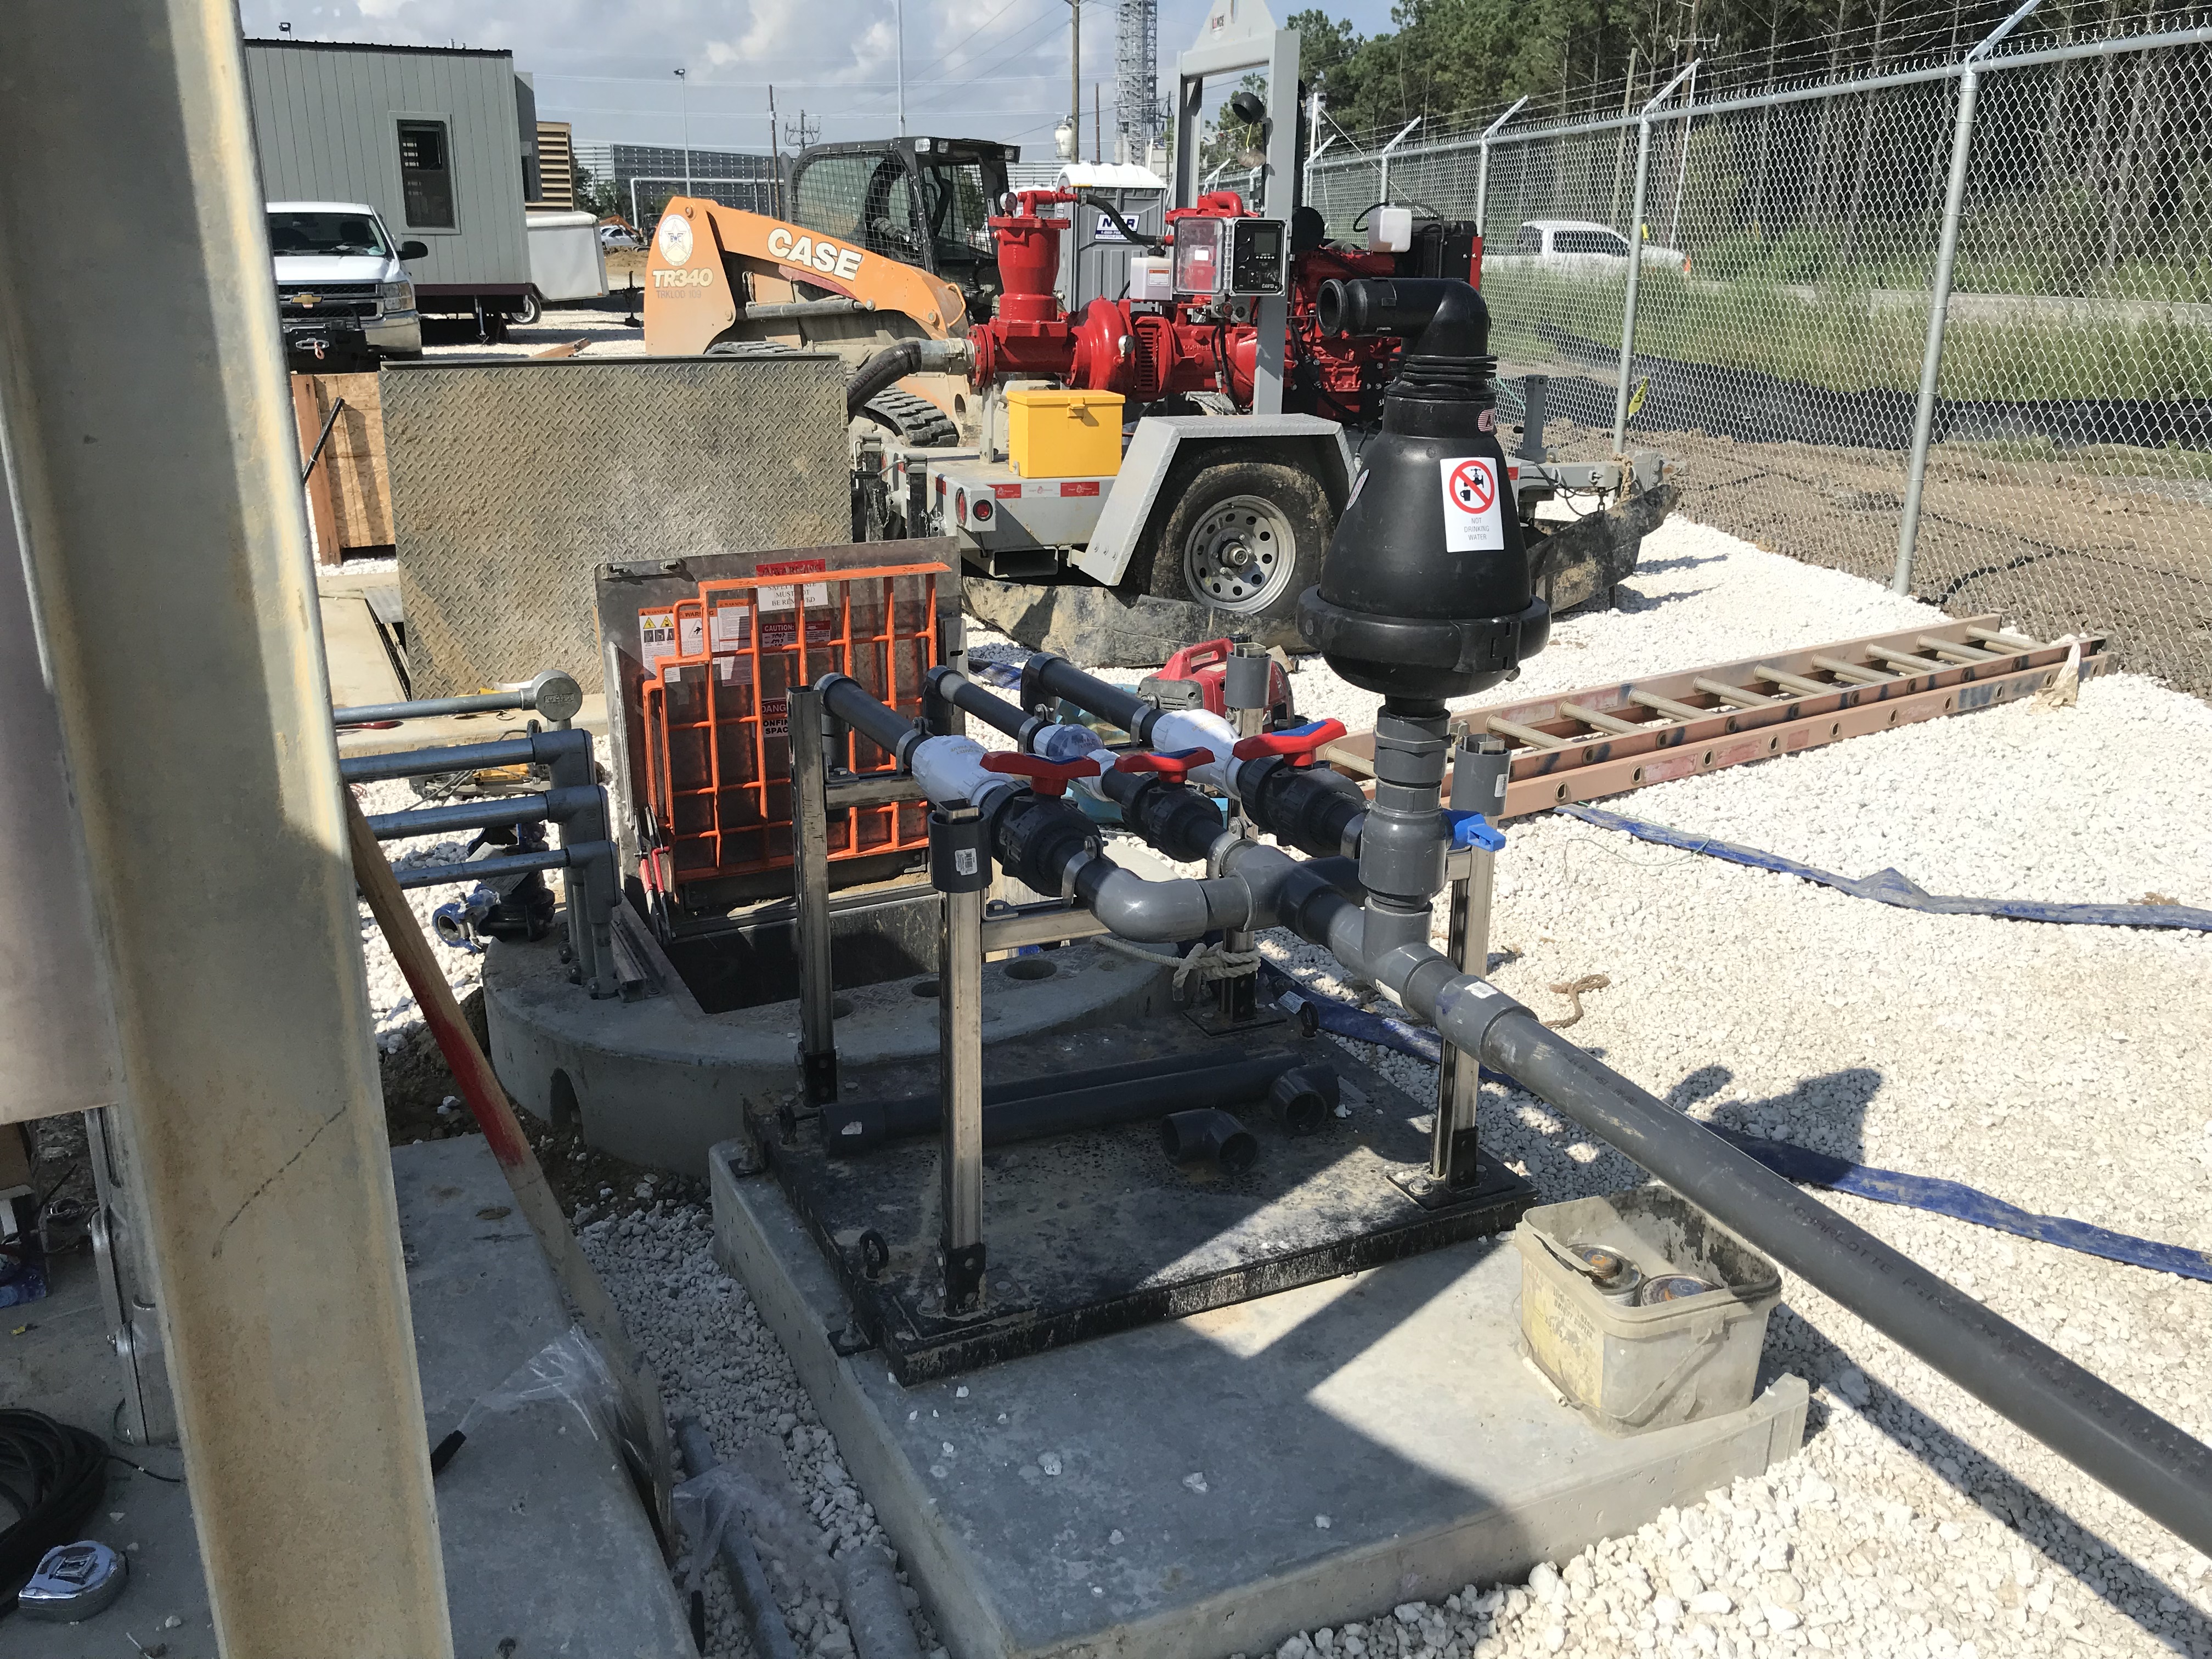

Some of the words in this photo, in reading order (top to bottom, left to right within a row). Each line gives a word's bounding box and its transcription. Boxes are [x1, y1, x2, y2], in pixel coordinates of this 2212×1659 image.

[1102, 218, 1135, 227] NR
[768, 228, 863, 281] CASE
[652, 268, 713, 288] TR340
[656, 290, 686, 298] TRKLOD
[689, 290, 702, 298] 109
[761, 704, 787, 713] DANG
[1791, 1204, 1894, 1276] CHARLOTTE
